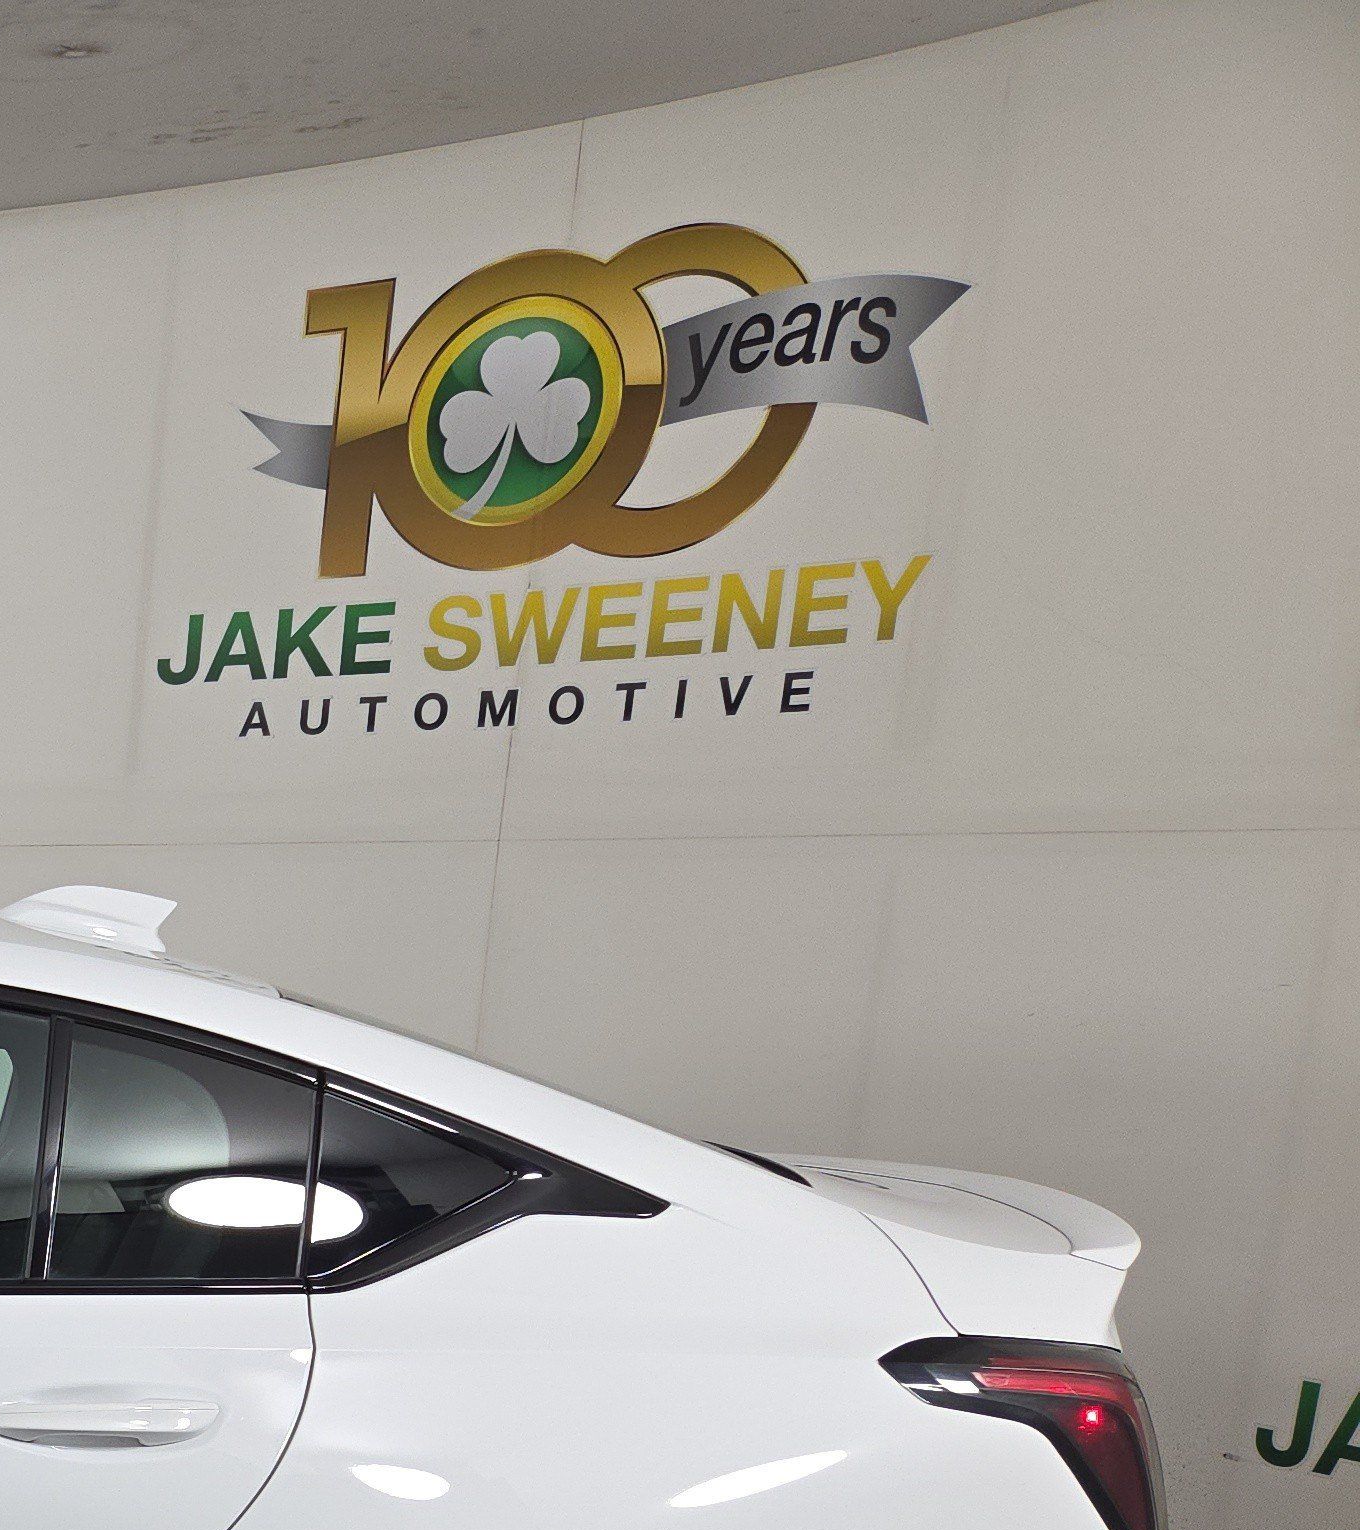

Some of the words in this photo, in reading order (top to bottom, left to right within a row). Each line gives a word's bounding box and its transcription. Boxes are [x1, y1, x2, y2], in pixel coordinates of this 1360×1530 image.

[685, 293, 897, 406] years
[156, 601, 396, 686] JAKE
[422, 554, 933, 673] SWEENEY
[238, 670, 816, 739] AUTOMOTIVE
